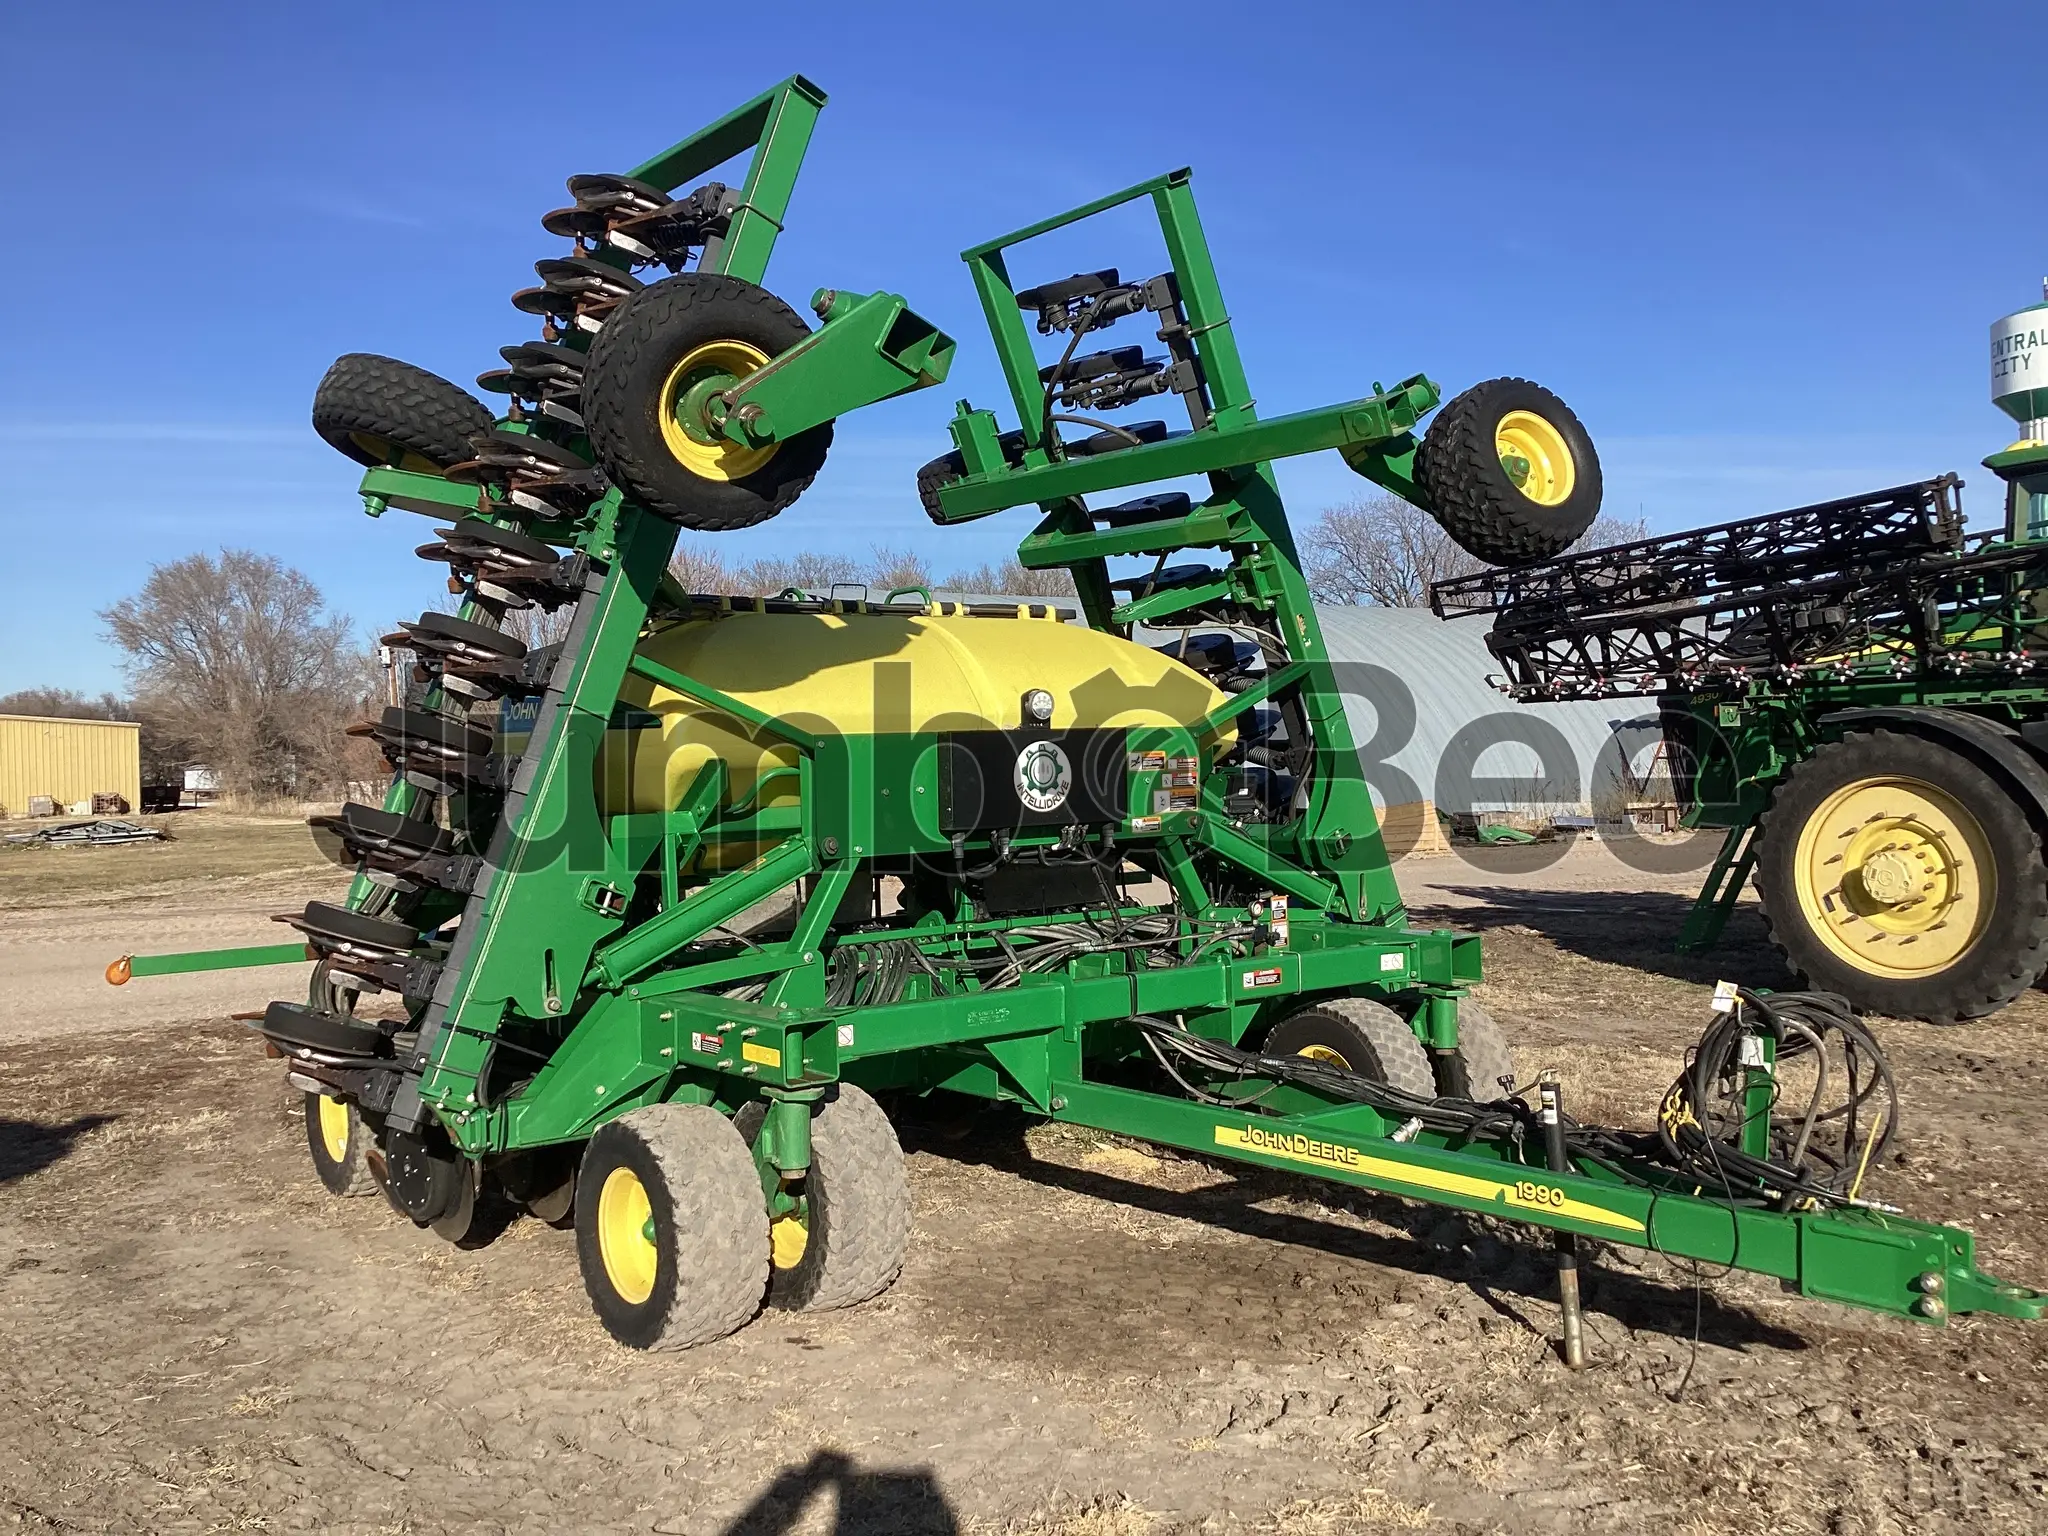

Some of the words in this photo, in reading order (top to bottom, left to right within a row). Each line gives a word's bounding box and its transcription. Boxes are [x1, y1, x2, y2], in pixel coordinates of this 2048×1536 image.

[1991, 328, 2048, 359] ENTRAL
[1994, 352, 2032, 379] CITY
[1941, 633, 1977, 645] DEEE
[504, 701, 539, 721] JOHN
[1016, 779, 1070, 810] INTELLIDRIVE
[1240, 1124, 1292, 1152] JOHN
[1292, 1133, 1360, 1165] DEERE
[1515, 1180, 1565, 1207] 1990
